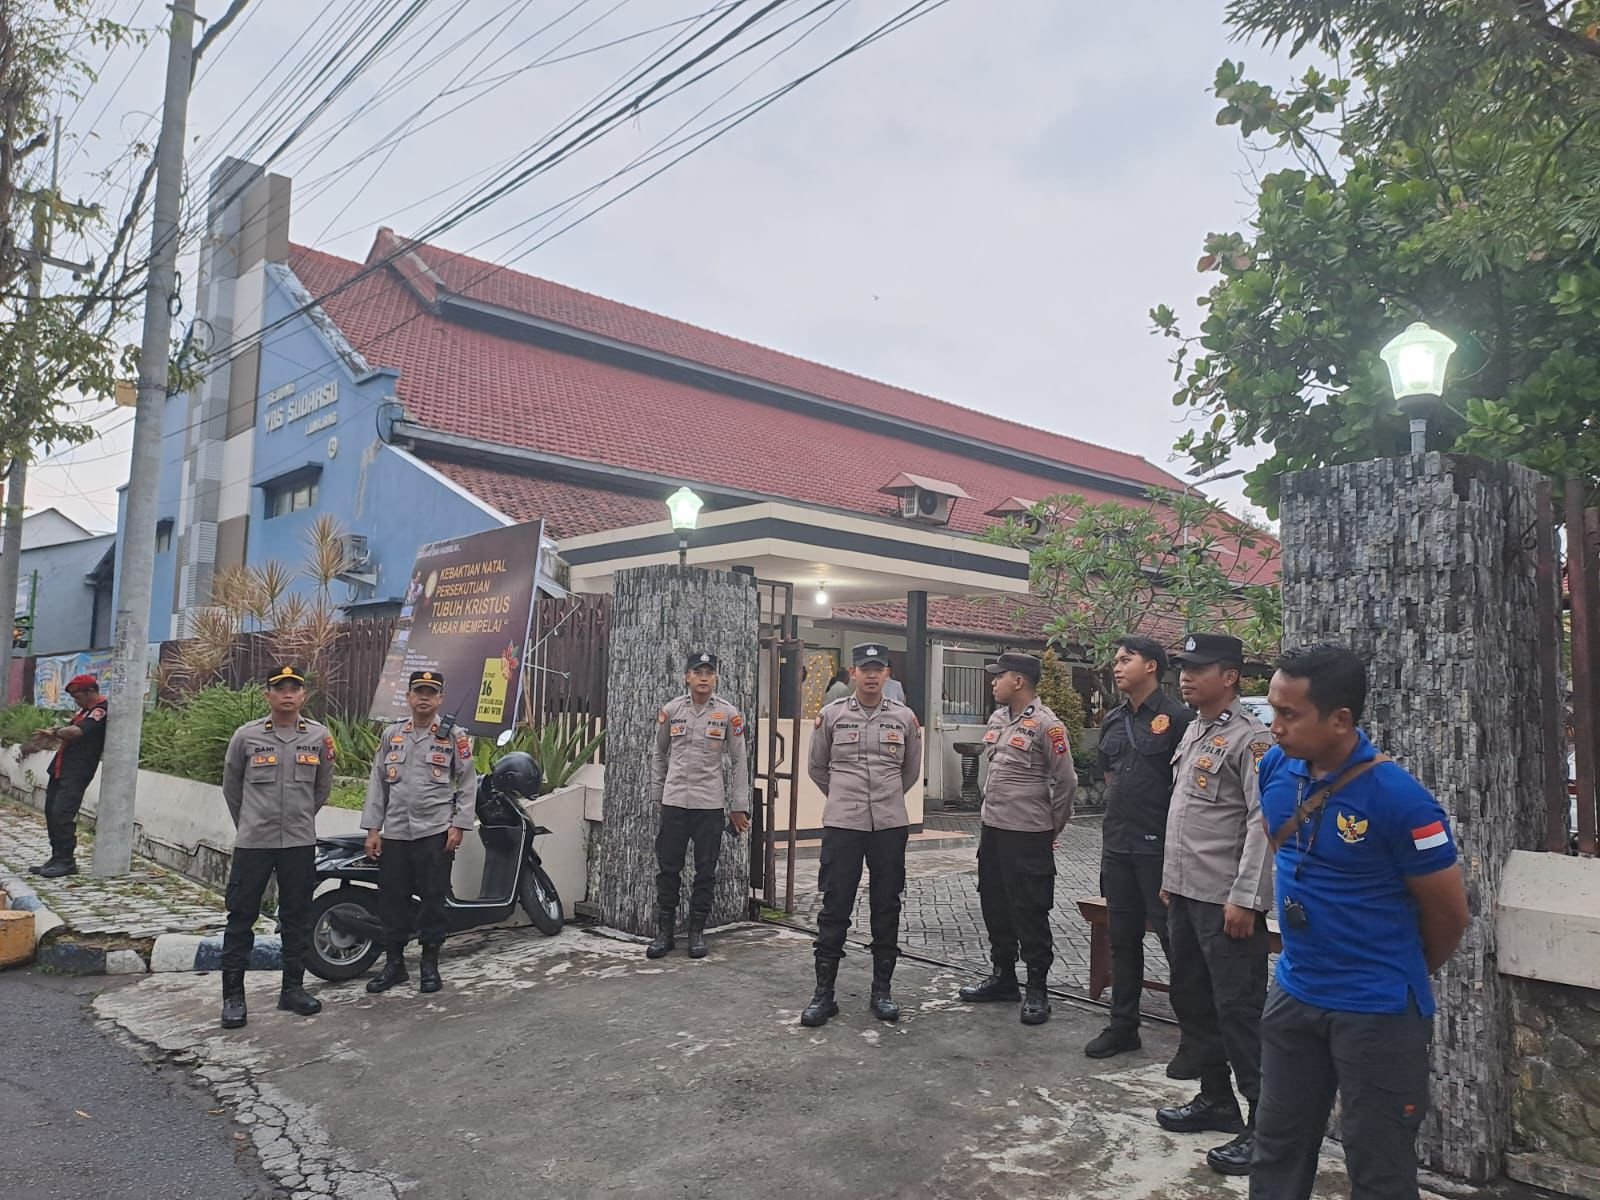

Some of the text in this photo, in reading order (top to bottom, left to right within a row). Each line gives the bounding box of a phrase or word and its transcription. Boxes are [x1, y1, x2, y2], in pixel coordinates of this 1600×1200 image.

[265, 379, 338, 433] YOS SUDARSO
[439, 559, 507, 581] KEBAKTIAN NATAL
[435, 580, 490, 598] PERSEKUTUAN
[431, 596, 511, 618] TUBUH KRISTUS
[481, 679, 493, 697] 16
[708, 720, 728, 728] POLRI
[879, 723, 903, 731] POLRI
[1016, 727, 1036, 738] POLRI
[430, 744, 453, 753] POLRI
[1200, 744, 1226, 757] POLRI
